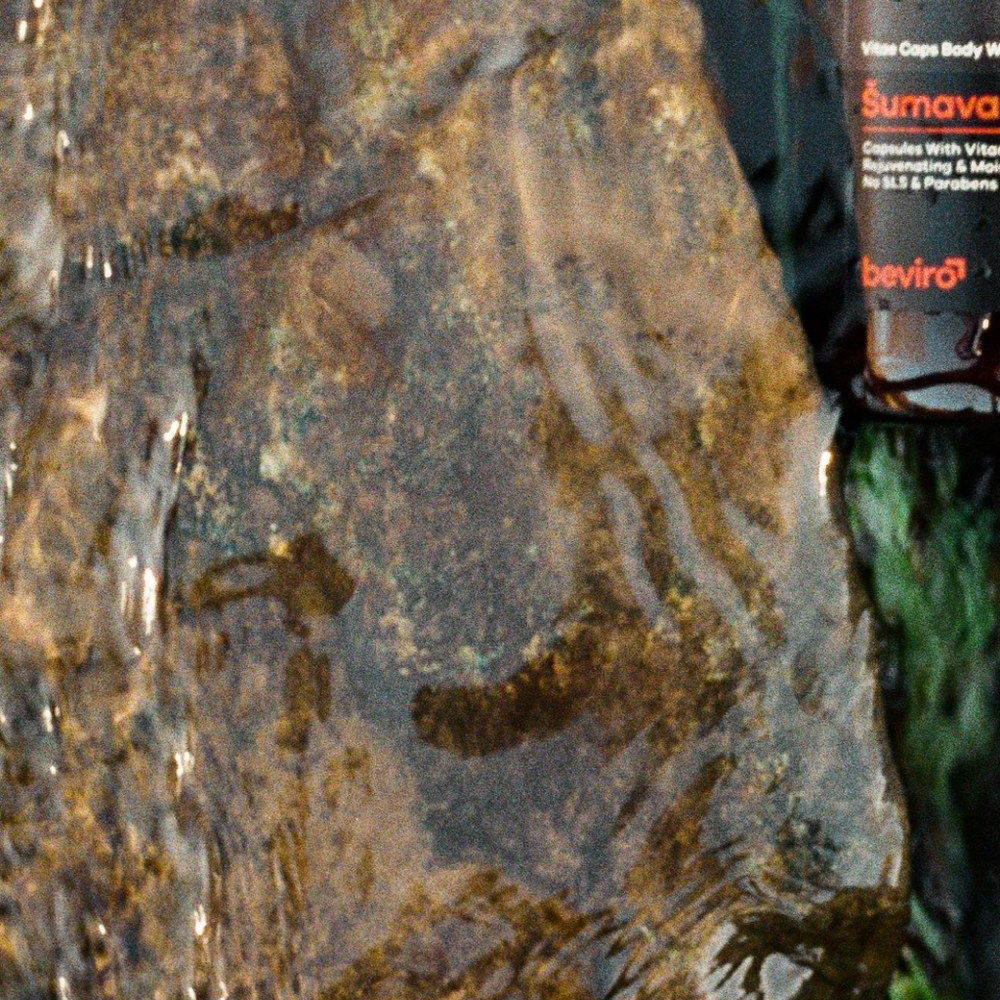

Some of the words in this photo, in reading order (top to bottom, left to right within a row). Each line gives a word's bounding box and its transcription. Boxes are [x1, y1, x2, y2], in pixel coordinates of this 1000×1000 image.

[899, 41, 939, 59] Caps
[941, 41, 983, 59] Body
[862, 78, 1000, 120] Šumava
[862, 141, 923, 158] Capsules
[925, 141, 962, 156] With
[862, 159, 952, 175] Rejuvenating
[955, 159, 967, 174] &
[910, 176, 922, 191] &
[924, 176, 999, 191] Parabens
[862, 254, 967, 290] beviro
